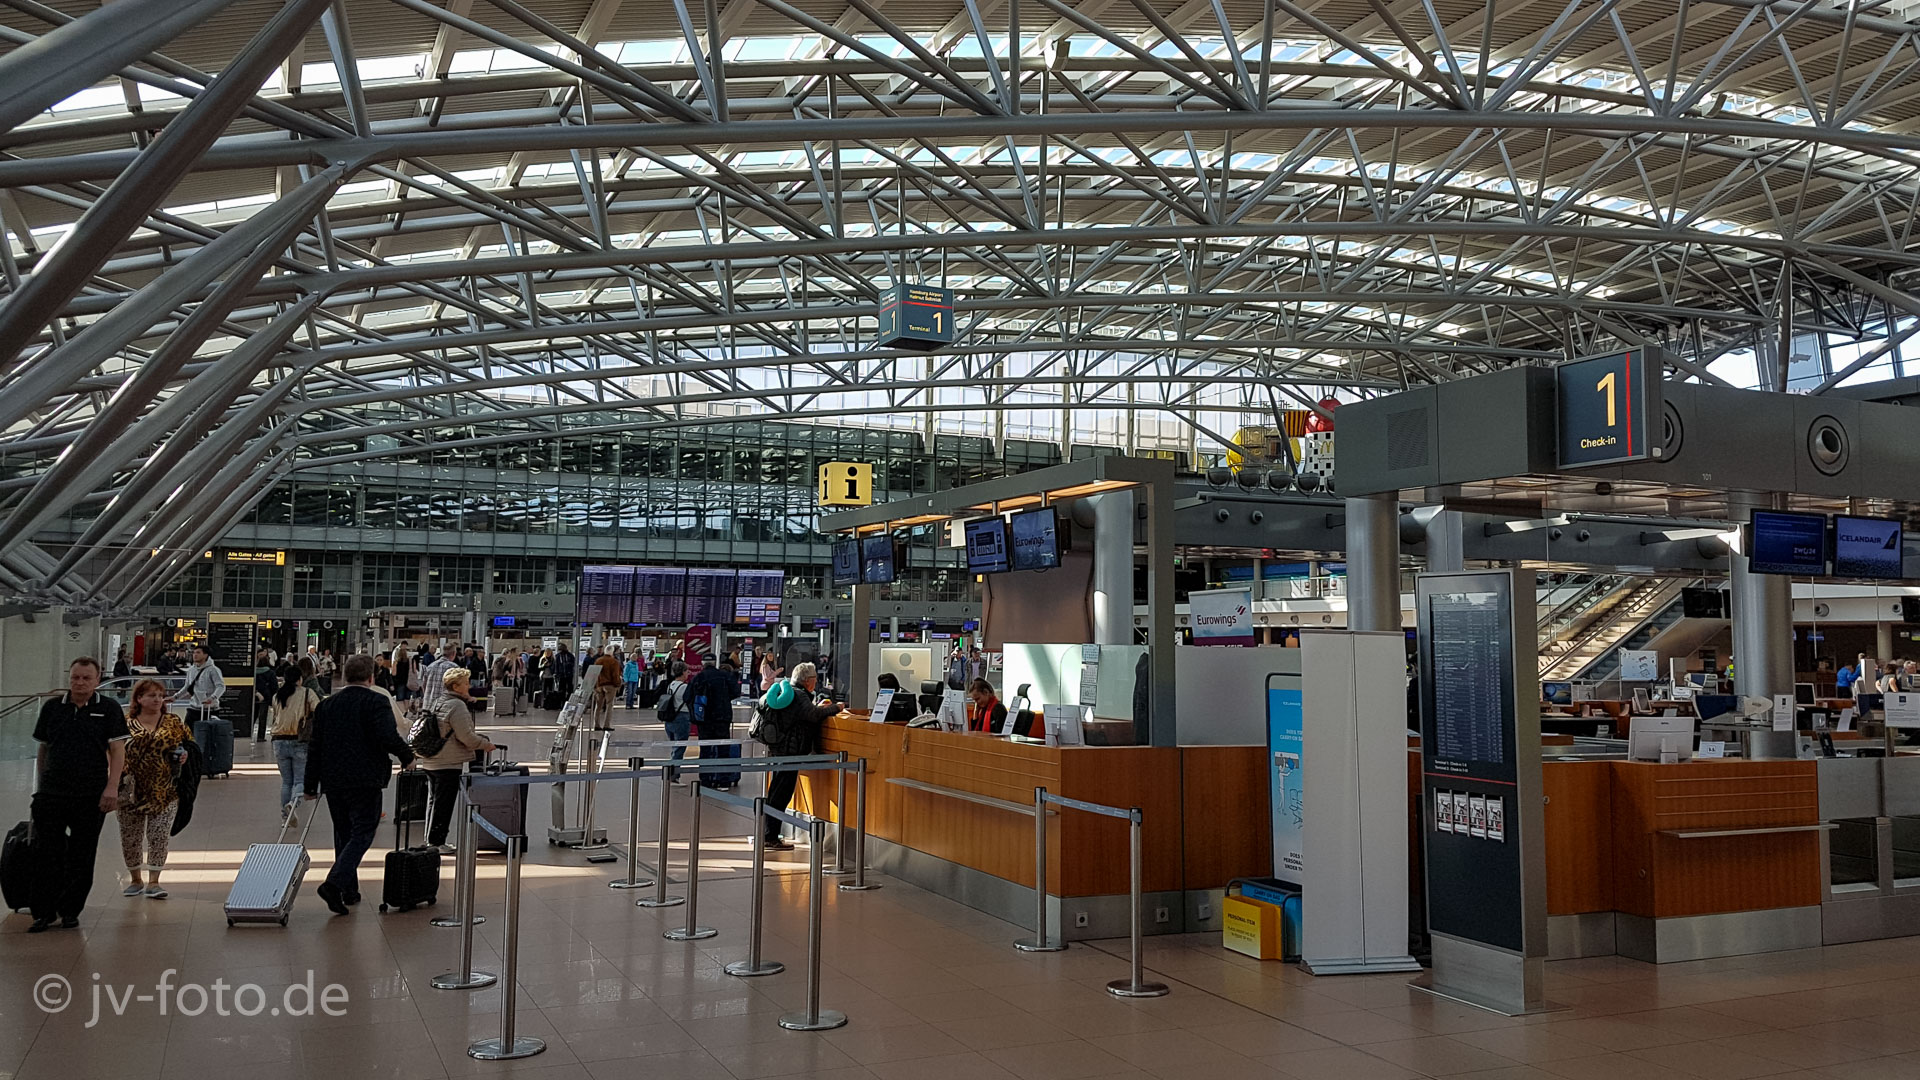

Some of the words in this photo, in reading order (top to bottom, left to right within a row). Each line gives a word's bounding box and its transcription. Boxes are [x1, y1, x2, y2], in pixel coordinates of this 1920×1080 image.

[909, 289, 928, 297] Hamburg
[891, 310, 896, 332] 1
[909, 324, 930, 332] Terminal
[933, 312, 942, 334] 1
[1597, 372, 1616, 427] 1
[1580, 435, 1617, 449] Check-in
[844, 466, 860, 500] i
[1702, 473, 1712, 481] 101
[1015, 534, 1045, 548] Eurowings
[1839, 533, 1882, 545] ICELANDAIR
[1196, 613, 1237, 627] Eurowings
[1227, 913, 1246, 923] PERSONAL
